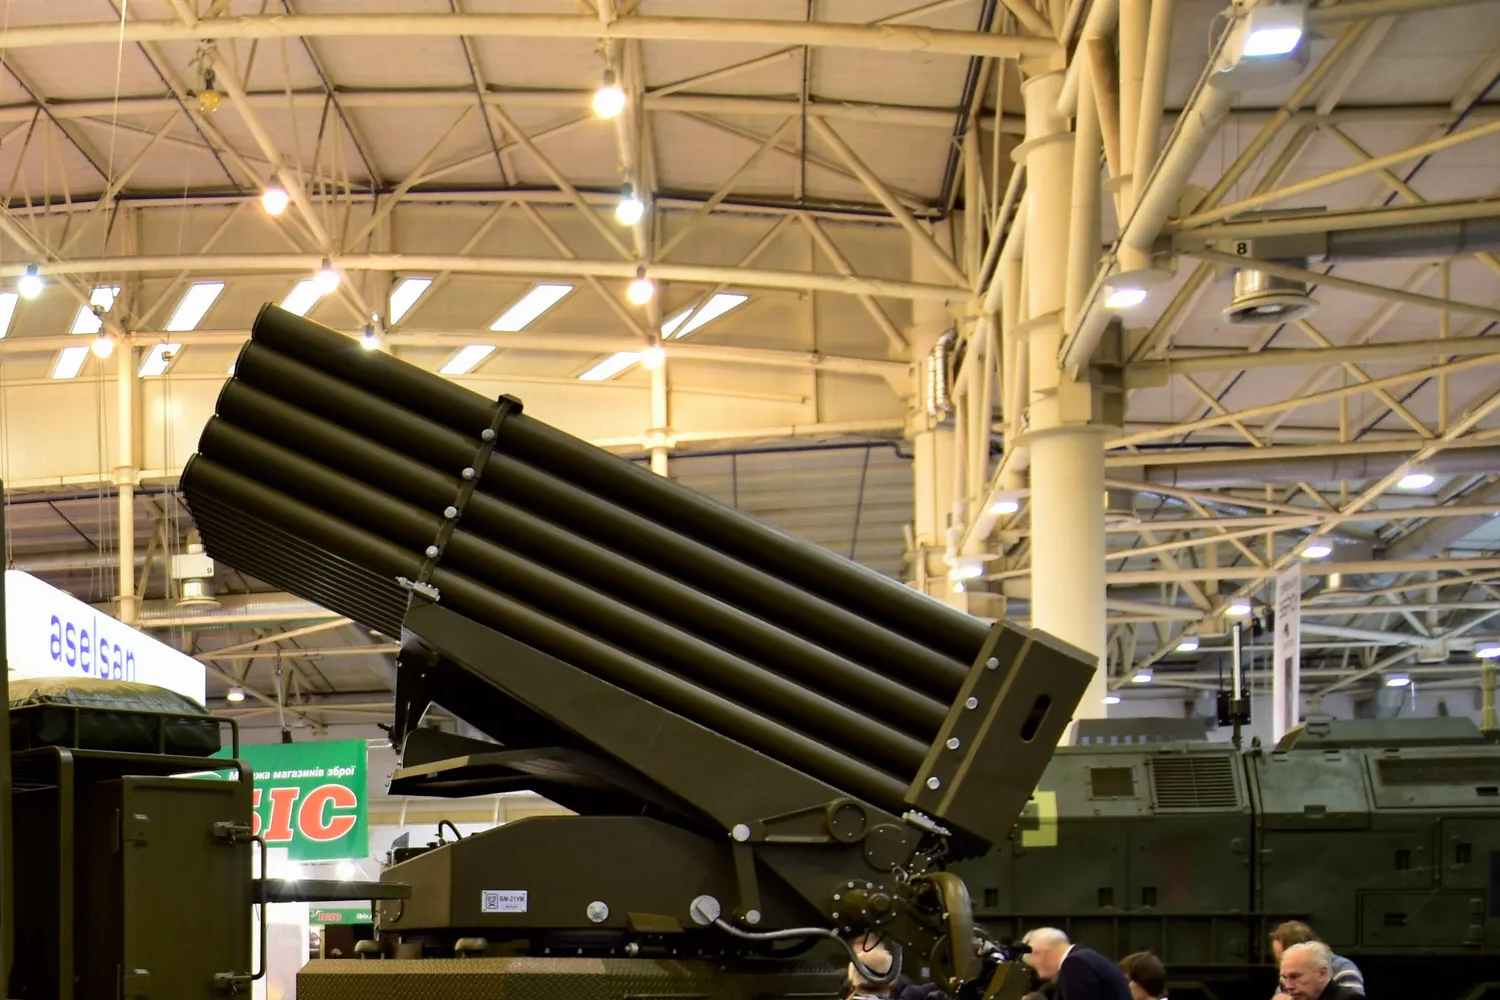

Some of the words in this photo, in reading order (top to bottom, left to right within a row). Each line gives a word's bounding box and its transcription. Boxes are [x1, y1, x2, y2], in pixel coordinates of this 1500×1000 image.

[1236, 242, 1248, 255] 8
[49, 614, 137, 682] aselsan
[273, 766, 324, 779] магазинів
[327, 765, 356, 778] зброї
